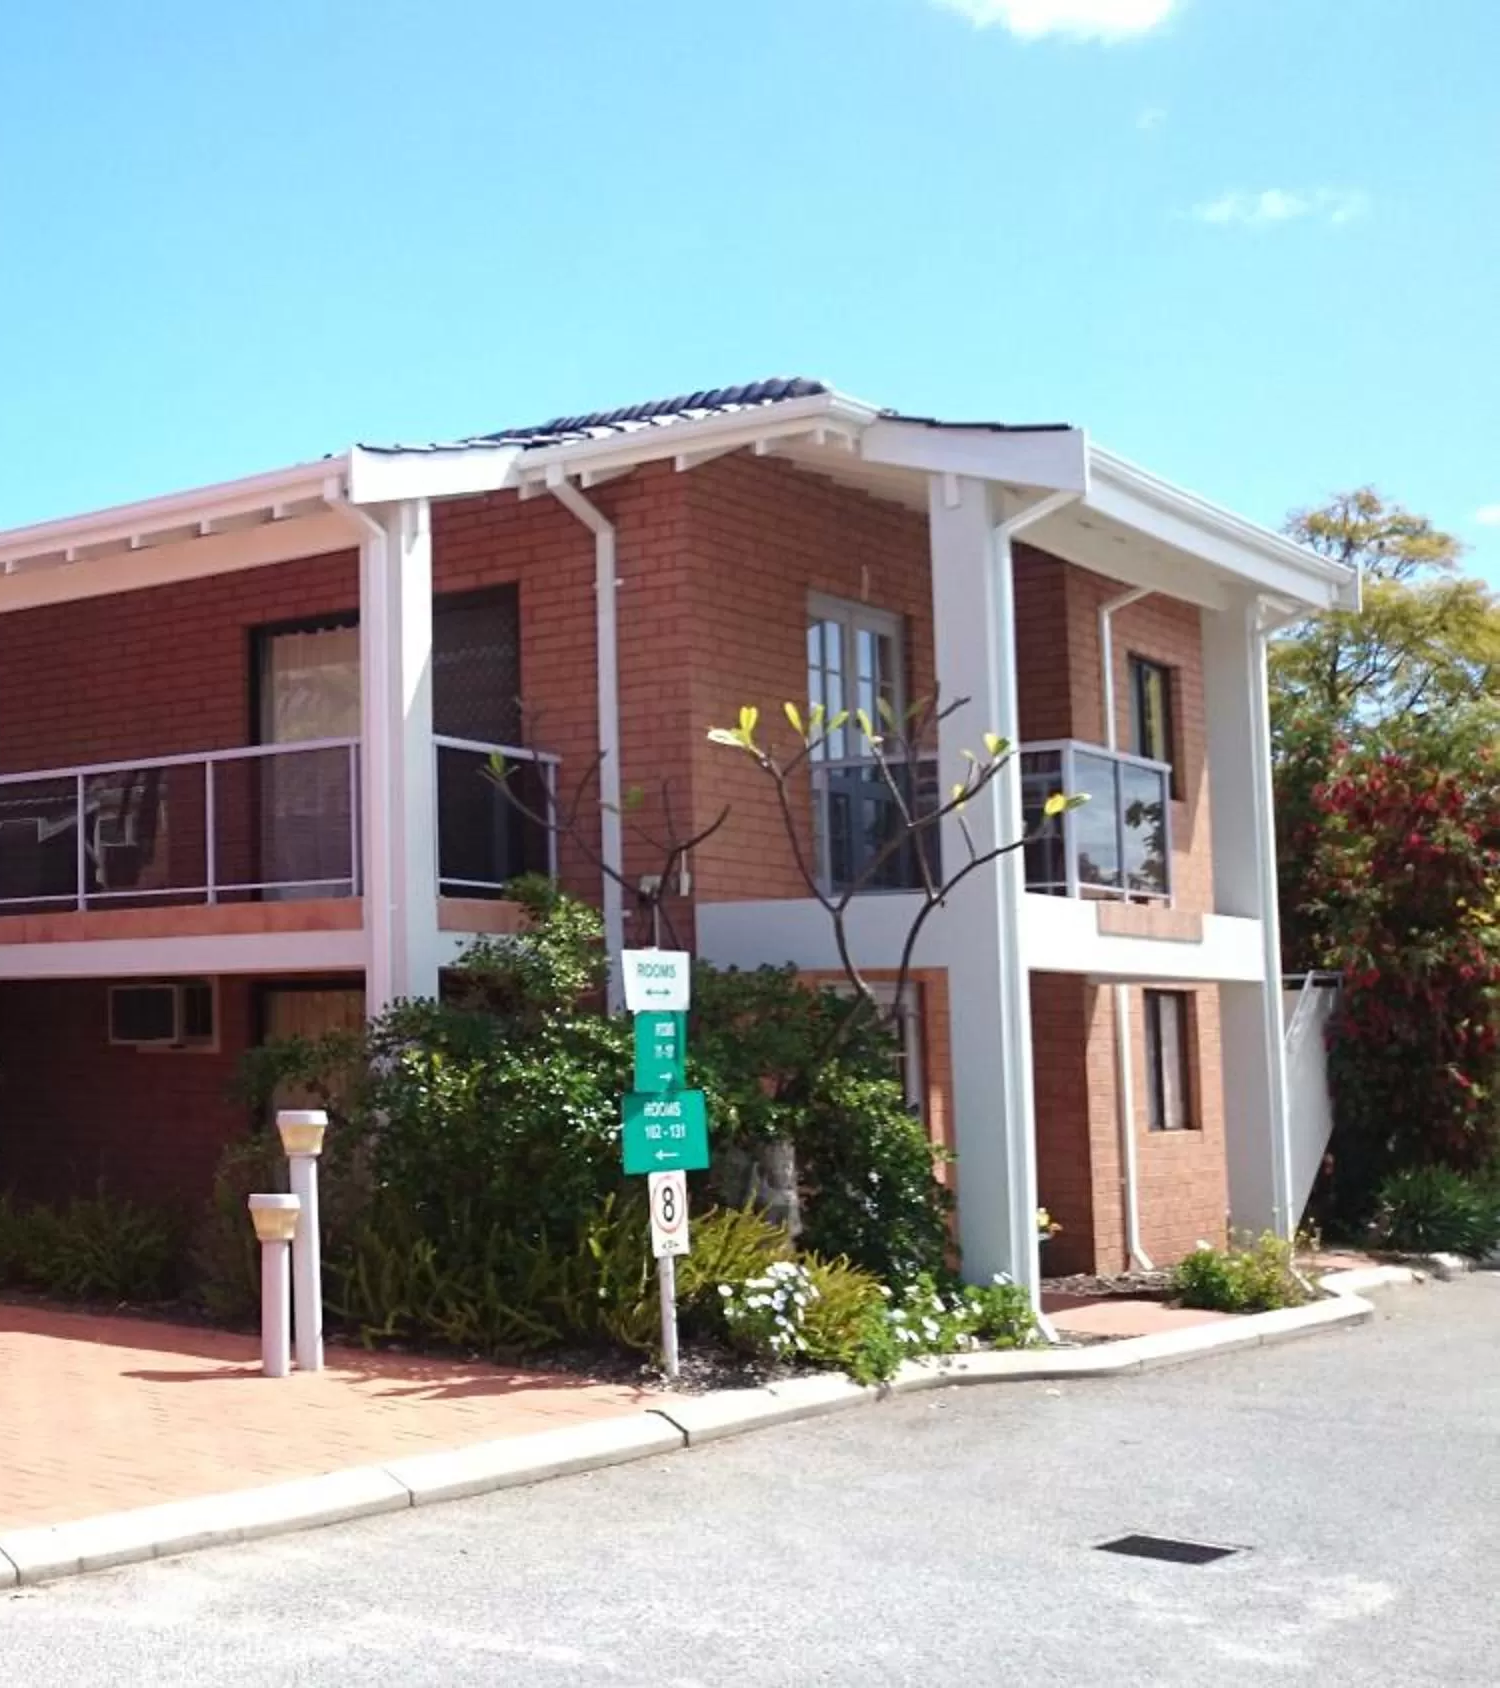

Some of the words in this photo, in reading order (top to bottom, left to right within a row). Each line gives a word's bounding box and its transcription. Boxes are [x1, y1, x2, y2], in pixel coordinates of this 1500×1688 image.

[636, 963, 677, 979] ROOMS
[643, 1101, 681, 1117] ROOMS
[661, 1186, 675, 1223] 8
